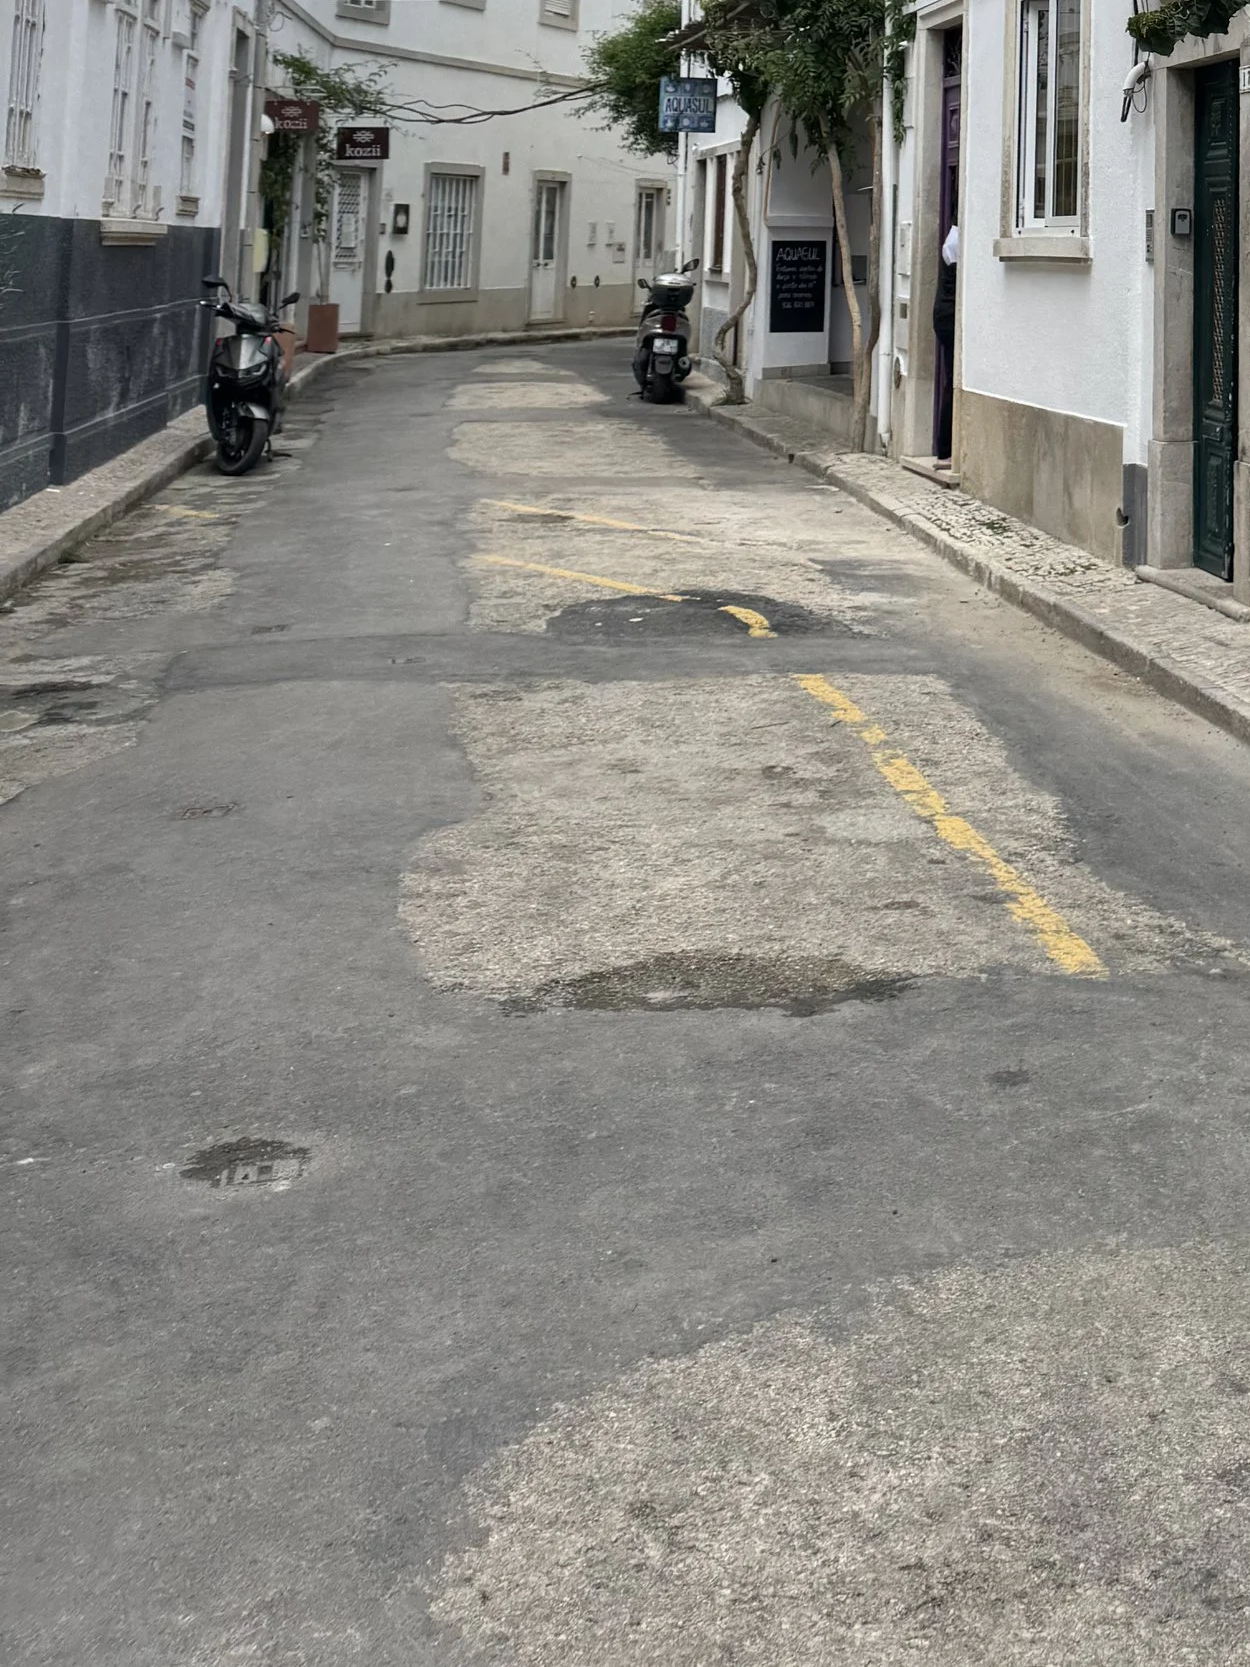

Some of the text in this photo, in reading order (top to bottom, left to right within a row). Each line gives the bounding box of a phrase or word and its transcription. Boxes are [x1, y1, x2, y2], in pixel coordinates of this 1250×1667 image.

[665, 97, 712, 113] AQUASUL
[275, 117, 308, 129] kozii
[345, 143, 381, 157] kozii
